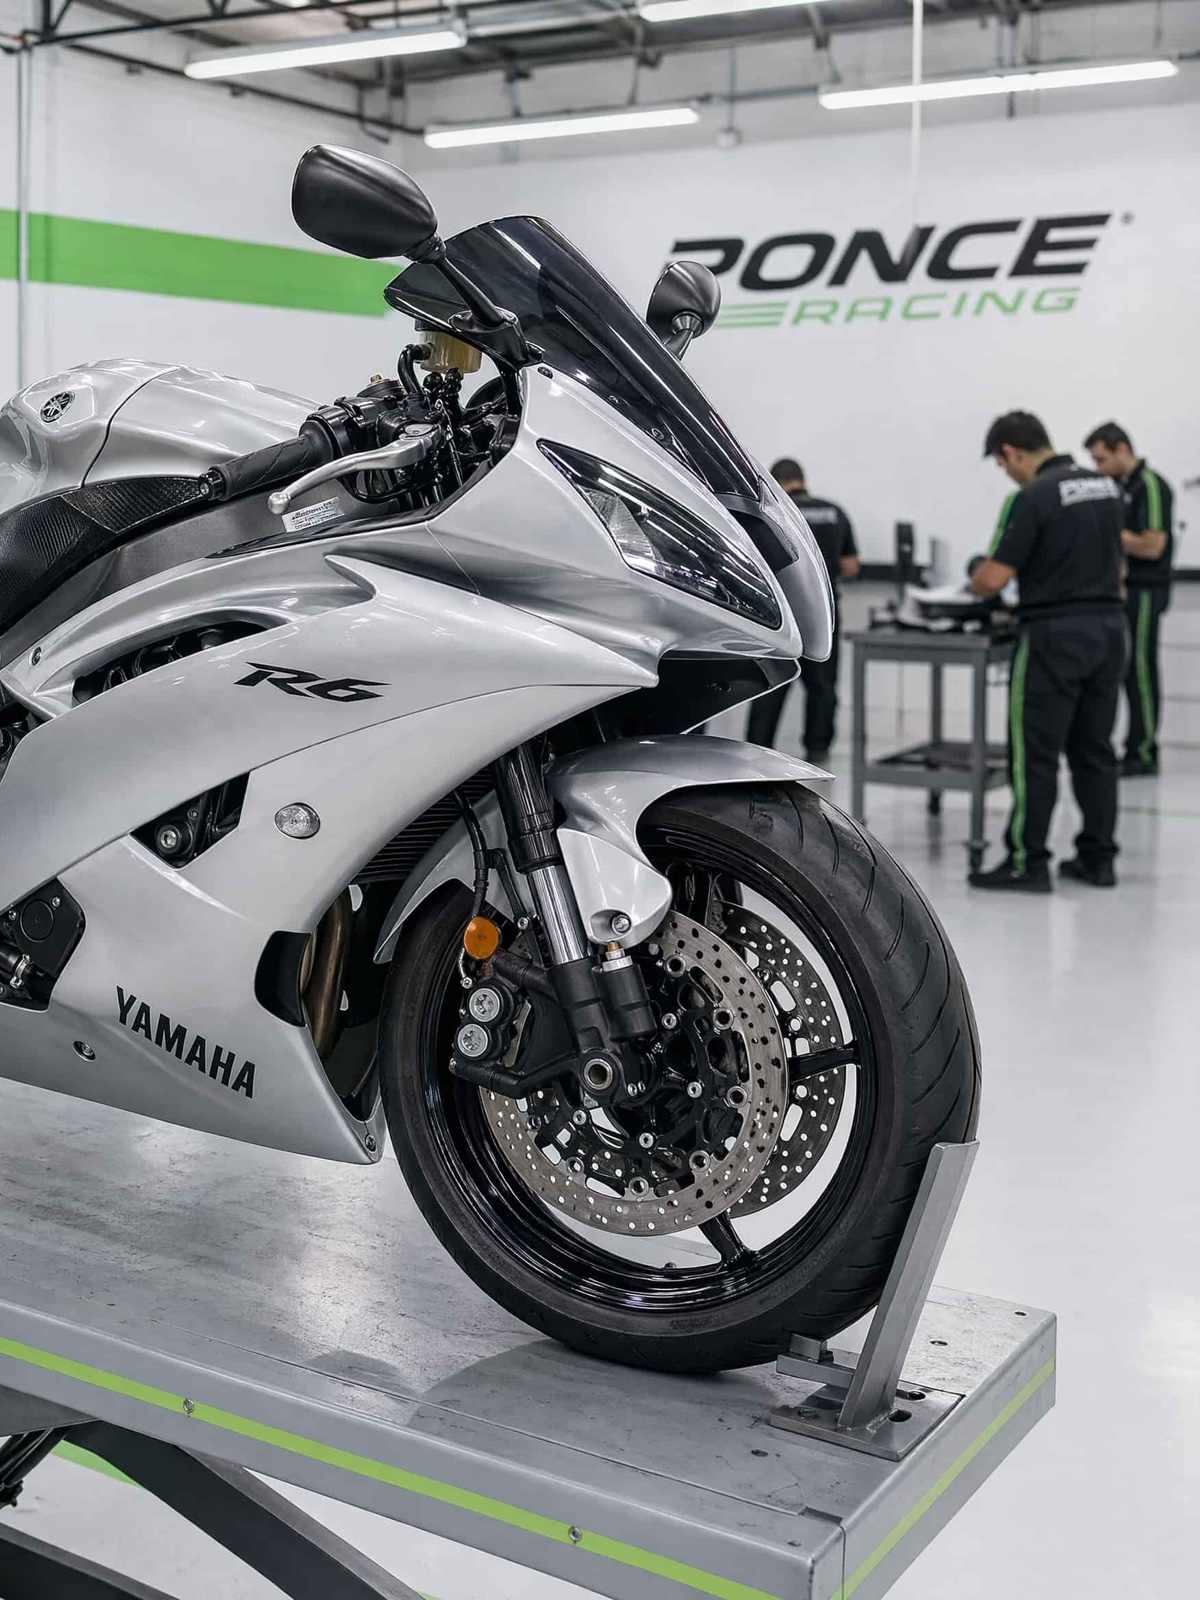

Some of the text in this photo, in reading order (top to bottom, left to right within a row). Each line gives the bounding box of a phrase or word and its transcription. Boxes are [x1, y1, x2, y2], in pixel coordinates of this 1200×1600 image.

[790, 286, 1081, 328] RACING
[233, 661, 393, 702] R6
[116, 985, 256, 1099] YAMAHA
